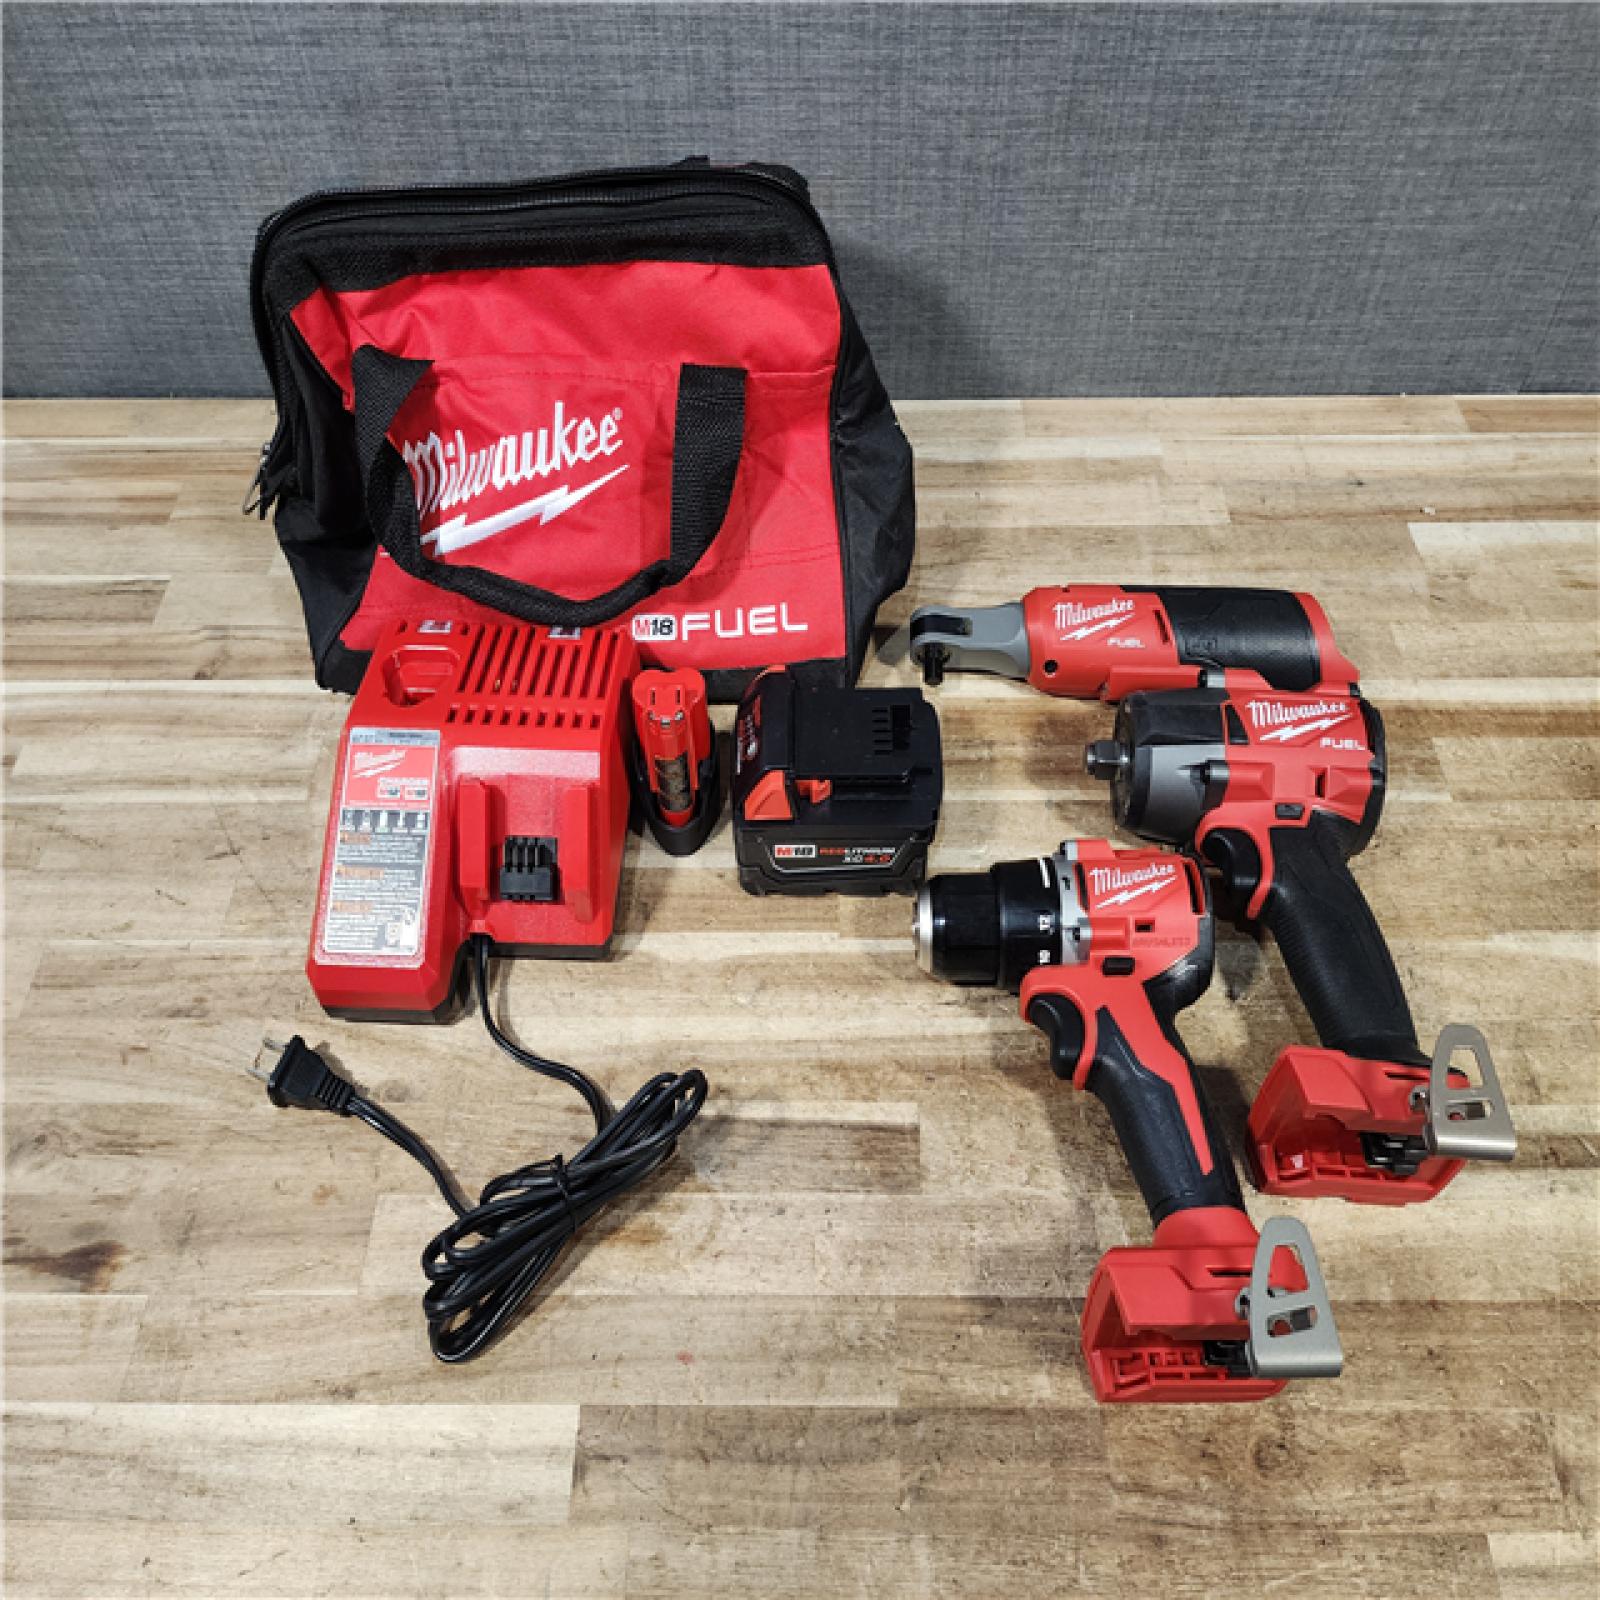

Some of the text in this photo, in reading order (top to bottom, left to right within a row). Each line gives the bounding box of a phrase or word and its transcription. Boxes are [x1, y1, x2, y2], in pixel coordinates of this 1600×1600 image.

[402, 400, 624, 519] Milwaukee
[633, 602, 808, 641] M18 FUEL
[1052, 597, 1135, 630] Milwaukee
[1107, 637, 1146, 649] FUEL
[1246, 699, 1348, 728] Milwaukee
[1319, 737, 1366, 751] FUEL
[1089, 862, 1176, 896] Milwaukee
